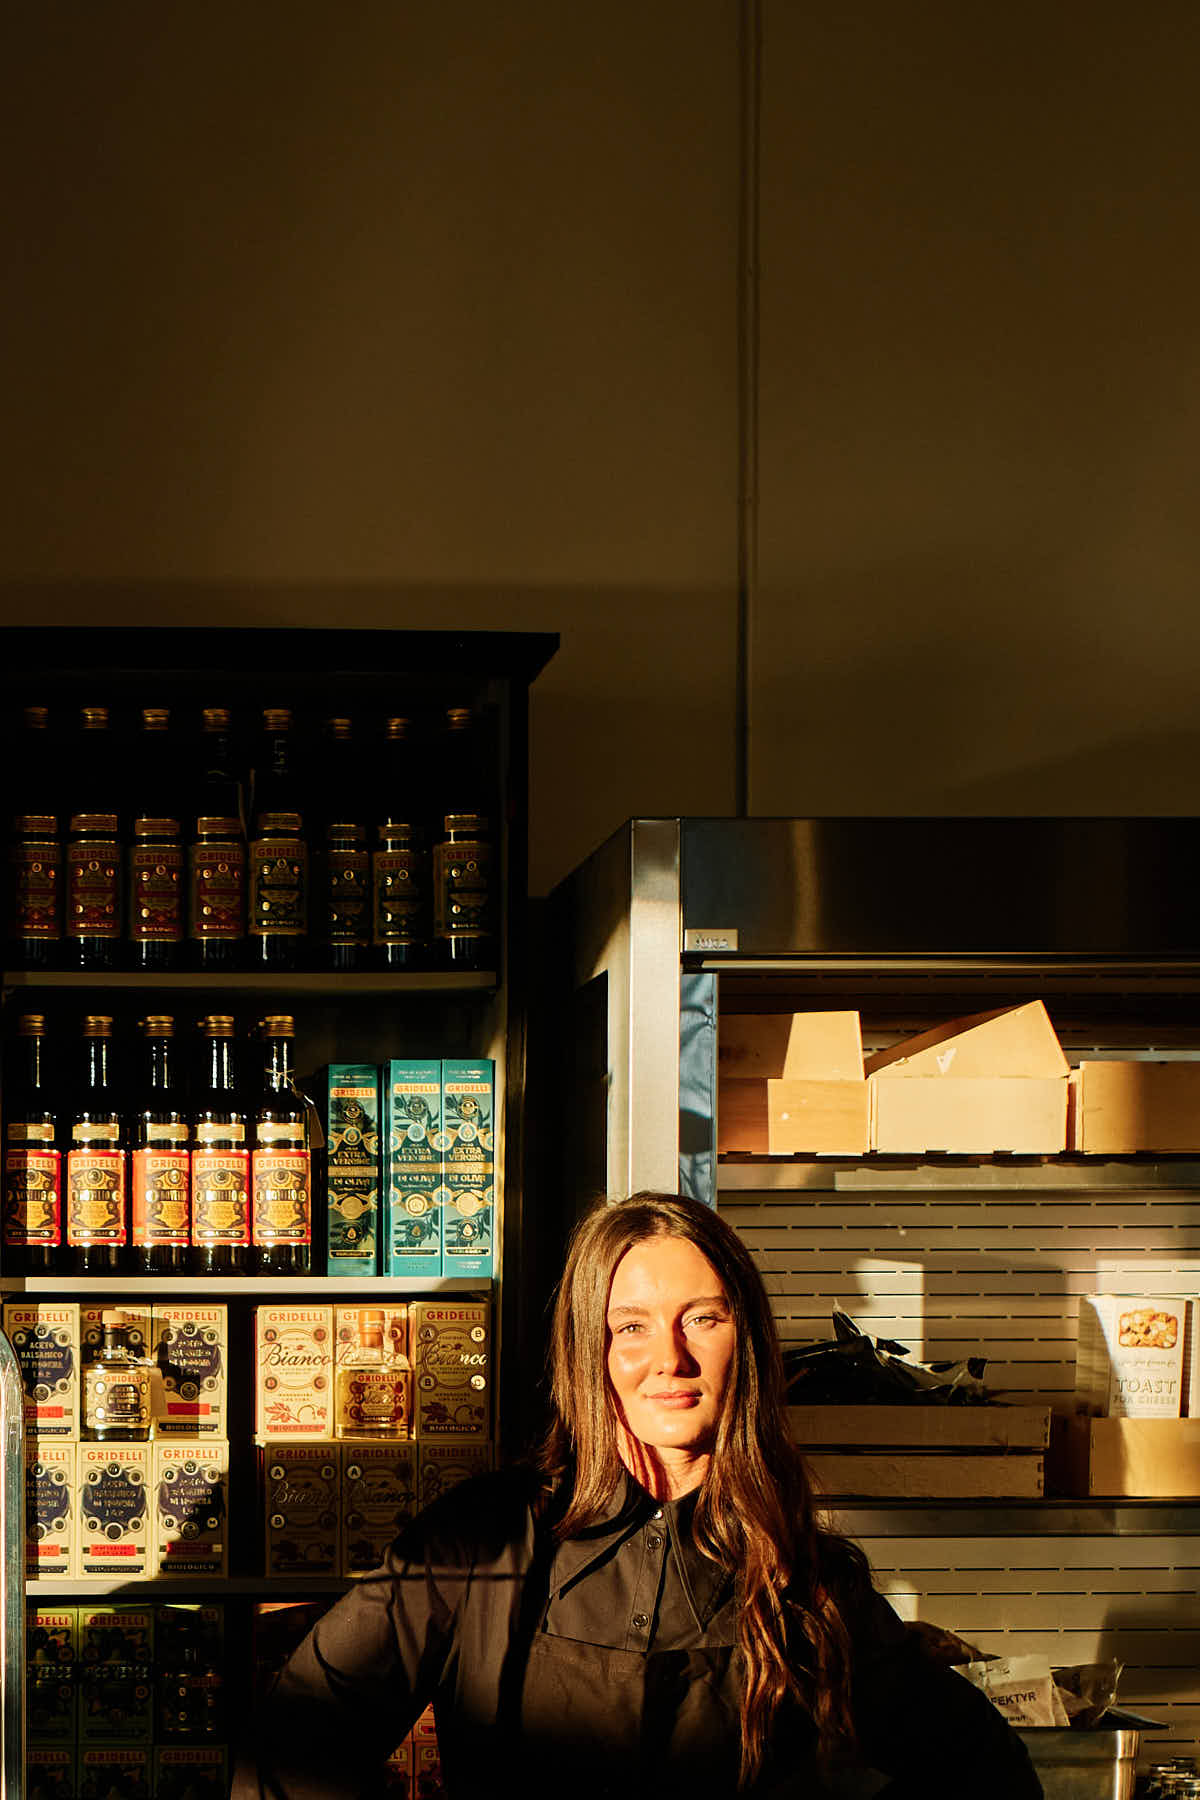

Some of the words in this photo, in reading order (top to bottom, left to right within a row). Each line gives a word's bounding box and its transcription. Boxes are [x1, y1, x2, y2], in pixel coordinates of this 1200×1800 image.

[14, 1312, 69, 1322] GRIDELLI
[163, 1311, 218, 1321] GRIDELLI
[269, 1311, 323, 1321] GRIDELLI
[426, 1310, 481, 1320] GRIDELLI
[260, 1342, 333, 1367] Bianco
[1115, 1377, 1177, 1393] TOAST
[87, 1451, 142, 1461] GRIDELLI
[163, 1449, 218, 1459] GRIDELLI
[276, 1449, 331, 1459] GRIDELLI
[352, 1449, 407, 1459] GRIDELLI
[89, 1614, 145, 1626] GRIDELLI
